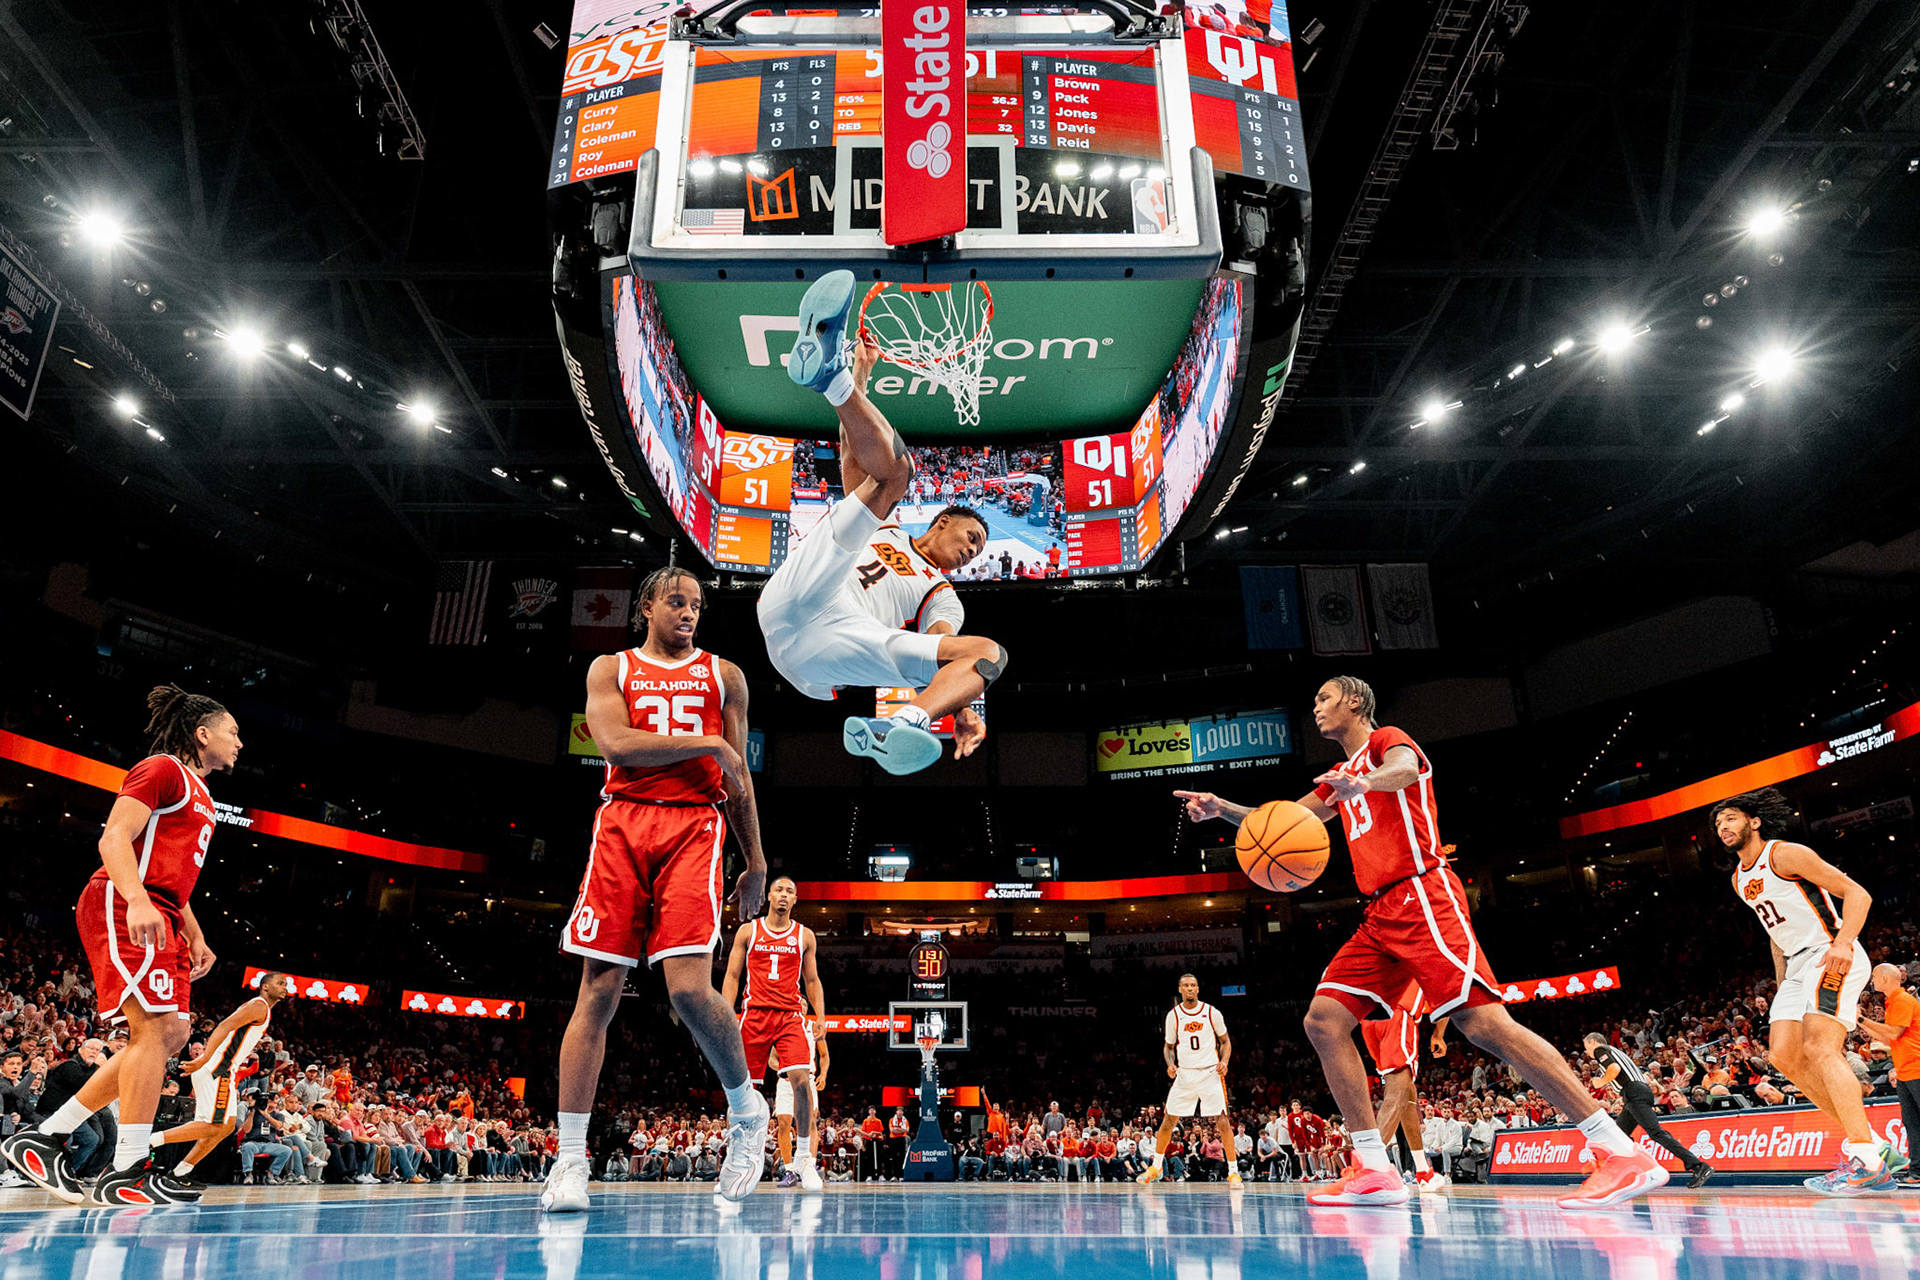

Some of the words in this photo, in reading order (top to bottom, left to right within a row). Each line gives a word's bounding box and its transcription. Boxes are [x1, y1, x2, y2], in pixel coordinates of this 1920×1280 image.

[772, 62, 789, 72] PTS
[810, 60, 826, 68] FLS
[903, 6, 950, 118] State
[1031, 61, 1039, 71] #
[1055, 62, 1097, 76] PLAYER
[775, 80, 784, 88] 4
[812, 76, 822, 85] 0
[1034, 77, 1040, 86] 1
[1054, 78, 1100, 92] Brown
[566, 99, 573, 109] #
[586, 86, 624, 104] PLAYER
[772, 93, 786, 102] 13
[812, 91, 820, 100] 2
[838, 96, 864, 104] FG%
[992, 96, 1017, 105] 36.2
[1032, 91, 1042, 100] 9
[1055, 92, 1090, 105] Pack
[1245, 92, 1260, 104] PTS
[1278, 100, 1292, 112] FLS
[564, 116, 573, 124] 0
[584, 105, 618, 120] Curry
[774, 108, 782, 116] 8
[812, 106, 818, 114] 1
[1001, 109, 1008, 117] 7
[1030, 106, 1045, 114] 12
[1055, 106, 1098, 120] Jones
[1246, 108, 1262, 119] 10
[1283, 116, 1289, 126] 1
[564, 130, 570, 138] 1
[582, 120, 614, 134] Clary
[770, 122, 784, 132] 13
[810, 120, 820, 129] 0
[998, 124, 1012, 132] 32
[1030, 120, 1046, 130] 13
[1056, 121, 1096, 134] Davis
[1248, 121, 1262, 132] 15
[1285, 130, 1291, 140] 1
[560, 144, 568, 152] 4
[580, 129, 636, 148] Coleman
[771, 138, 782, 147] 0
[811, 135, 817, 144] 1
[1030, 135, 1048, 144] 35
[1056, 136, 1090, 149] Reid
[1253, 136, 1262, 146] 9
[1286, 145, 1294, 154] 2
[558, 158, 566, 168] 9
[579, 150, 603, 162] Roy
[1255, 151, 1263, 161] 3
[1288, 159, 1294, 168] 1
[554, 172, 567, 183] 21
[576, 160, 633, 178] Coleman
[1257, 166, 1265, 176] 5
[1289, 174, 1298, 183] 0
[6, 281, 37, 320] THUNDER
[34, 286, 51, 315] CITY
[701, 451, 713, 487] 51
[1144, 452, 1154, 488] 51
[744, 478, 768, 505] 51
[1088, 479, 1112, 507] 51
[870, 542, 918, 576] OSU
[856, 560, 888, 590] 4
[512, 578, 558, 596] THUNDER
[631, 680, 710, 692] OKLAHOMA
[897, 690, 909, 699] 51
[634, 696, 705, 736] 35
[1196, 722, 1241, 757] LOUD
[1246, 722, 1287, 748] CITY
[1829, 729, 1873, 748] PRESENTED
[1872, 724, 1882, 734] BY
[1836, 731, 1894, 760] StateFarm
[581, 758, 605, 766] BRIN
[1111, 770, 1141, 780] BRING
[1144, 768, 1164, 777] THE
[1166, 764, 1214, 775] THUNDER
[1230, 760, 1253, 769] EXIT
[1256, 758, 1280, 767] NOW
[194, 802, 216, 826] OKLA
[1344, 793, 1373, 842] 13
[194, 824, 212, 868] 9
[998, 890, 1042, 898] StateFarm
[1744, 878, 1764, 901] OSU
[1755, 900, 1786, 928] 21
[577, 906, 599, 942] OU
[755, 944, 797, 954] OKLAHOMA
[1158, 940, 1189, 951] PARTY
[1191, 937, 1232, 950] TERRACE
[919, 950, 942, 960] 11:31
[768, 954, 779, 980] 1
[918, 960, 940, 977] 30
[149, 969, 174, 1000] OU
[1008, 1006, 1098, 1018] THUNDER
[859, 1018, 905, 1028] StateFarm
[1190, 1036, 1200, 1050] 0
[1716, 1125, 1824, 1158] StateFarm
[1512, 1141, 1571, 1164] StateFarm
